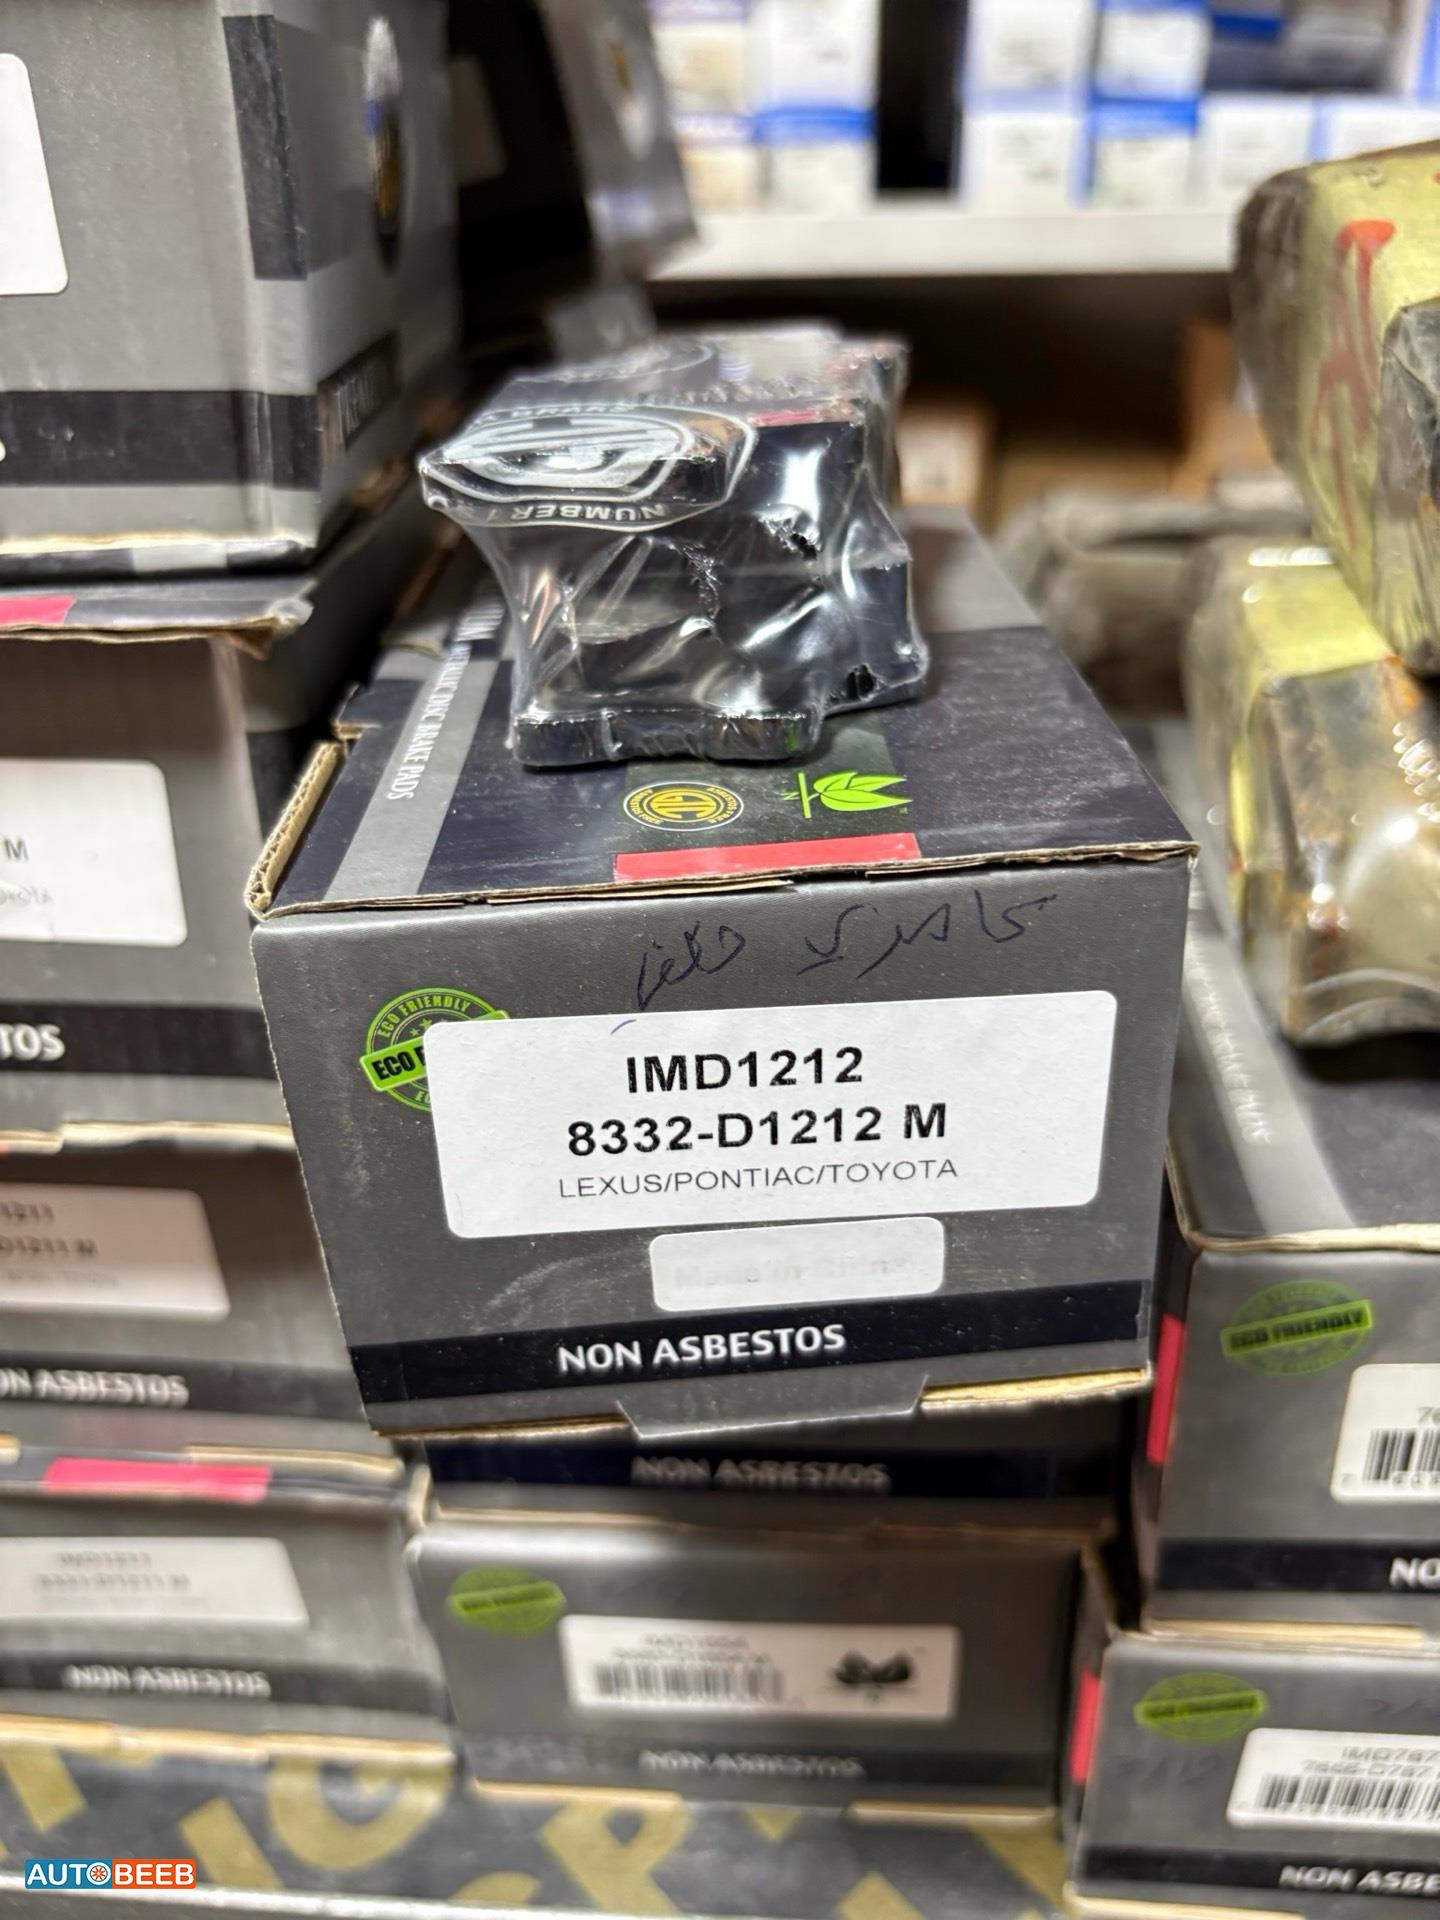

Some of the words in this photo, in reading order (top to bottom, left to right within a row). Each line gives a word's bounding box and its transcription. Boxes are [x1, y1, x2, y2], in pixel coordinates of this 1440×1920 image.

[510, 503, 668, 523] NUMBER
[402, 722, 443, 764] BRAKE
[386, 762, 427, 801] PADS
[378, 1014, 401, 1038] ECO
[397, 995, 472, 1017] FRIENDLY
[371, 1051, 417, 1081] ECO
[626, 1046, 864, 1094] IMD1212
[567, 1105, 882, 1157] 8332-D1212
[904, 1102, 947, 1140] M
[559, 1158, 958, 1199] LEXUS/PONTIAC/TOYOTA
[558, 1339, 642, 1372] NON
[652, 1323, 846, 1366] ASBESTOS
[631, 1455, 711, 1487] NON
[714, 1458, 893, 1494] ASBESTOS
[1279, 1865, 1358, 1892] NON
